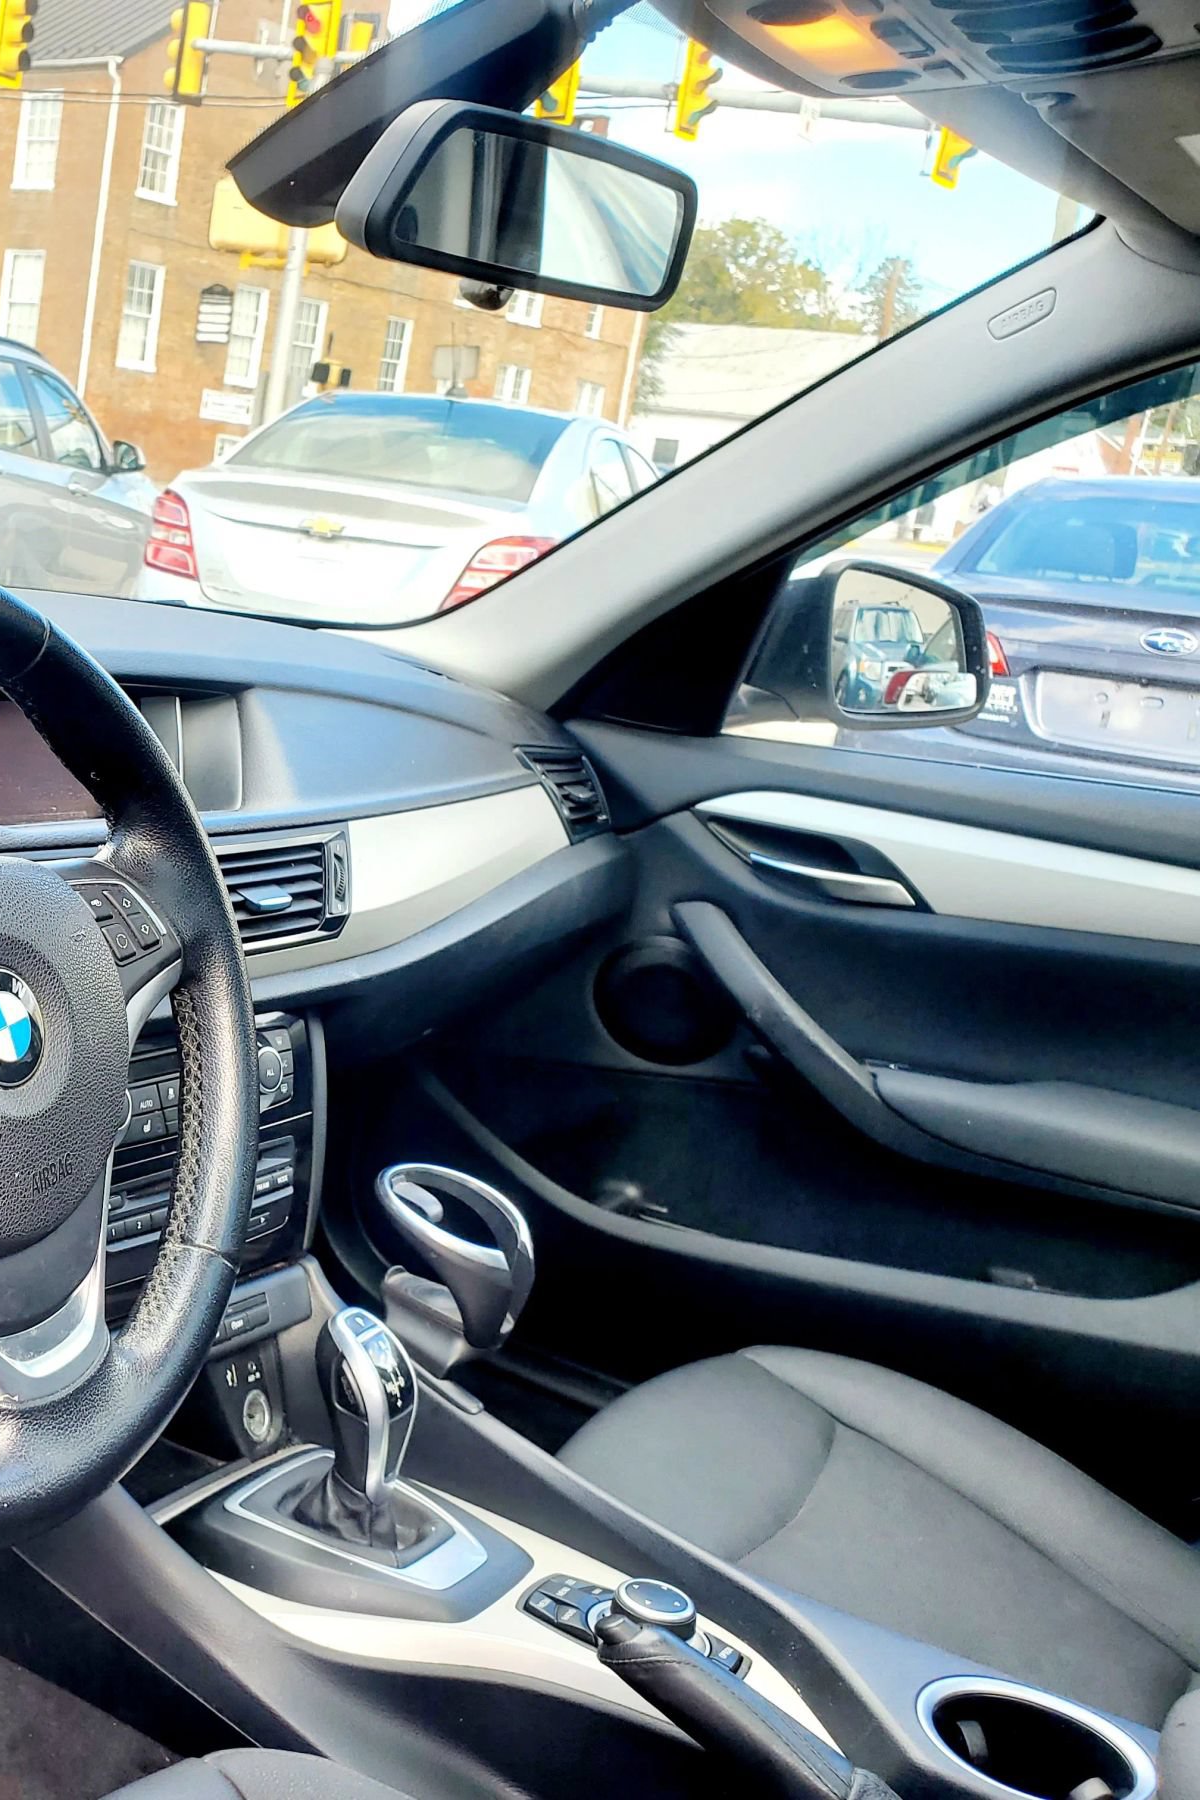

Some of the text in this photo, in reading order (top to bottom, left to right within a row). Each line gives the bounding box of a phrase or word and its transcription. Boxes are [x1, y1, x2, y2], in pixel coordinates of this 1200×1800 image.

[139, 1099, 153, 1109] AUTO
[31, 1153, 73, 1197] AIRBAG
[137, 1221, 142, 1229] 2
[112, 1228, 116, 1236] 1
